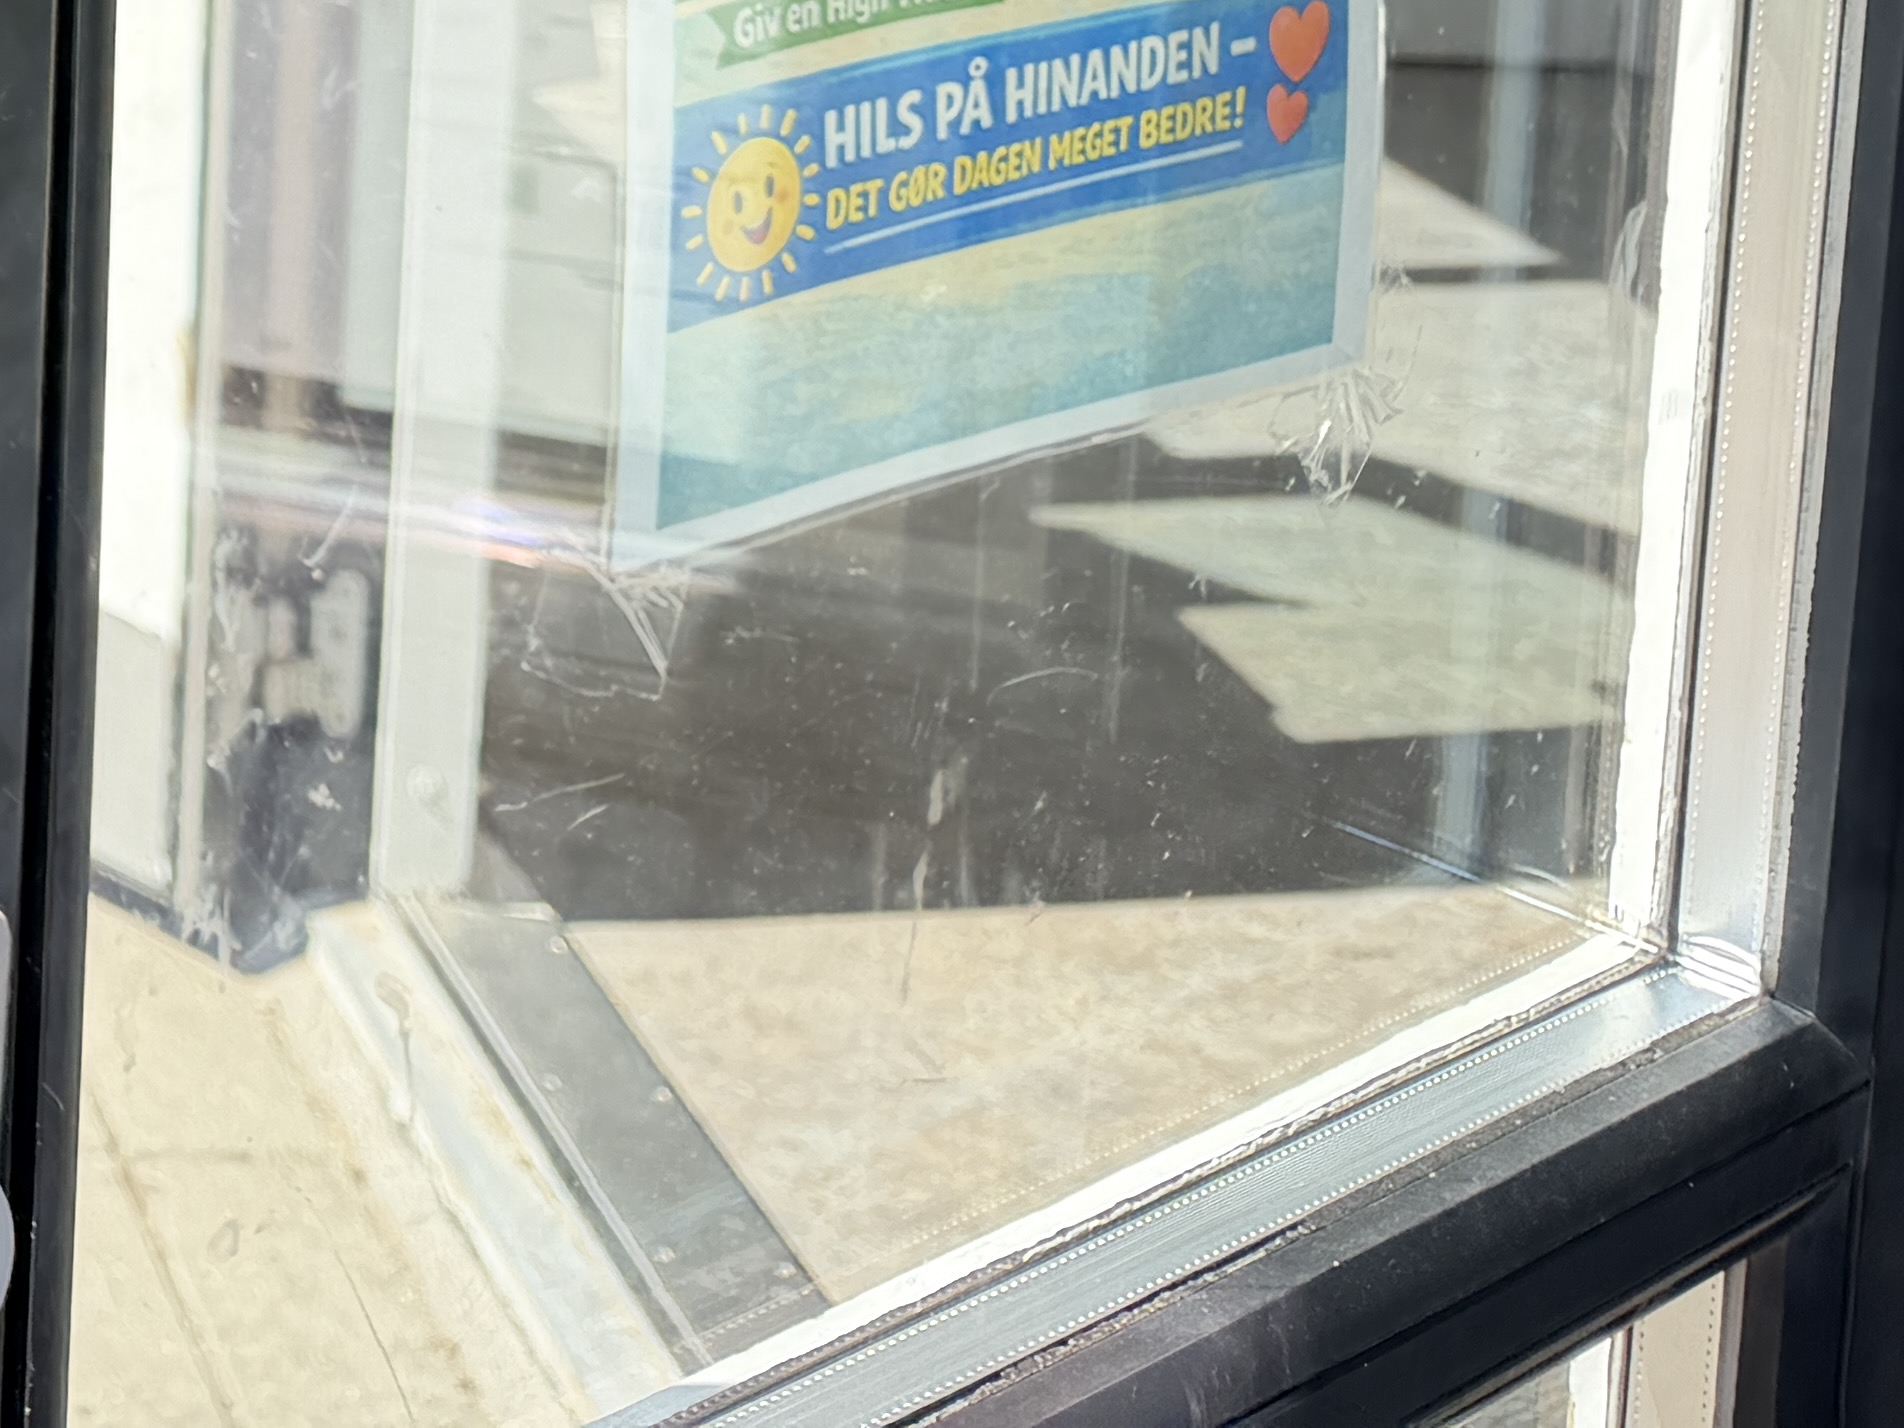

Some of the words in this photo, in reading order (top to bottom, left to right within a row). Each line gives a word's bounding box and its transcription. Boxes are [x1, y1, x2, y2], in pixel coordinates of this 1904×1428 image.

[733, 2, 782, 48] Giv
[824, 89, 924, 170] HILS
[935, 55, 994, 142] PÅ
[1005, 20, 1221, 126] HINANDEN
[825, 178, 885, 231] DET
[888, 162, 948, 213] GØR
[953, 136, 1043, 196] DAGEN
[1047, 115, 1135, 172] MEGET
[1138, 85, 1247, 151] BEDRE!
